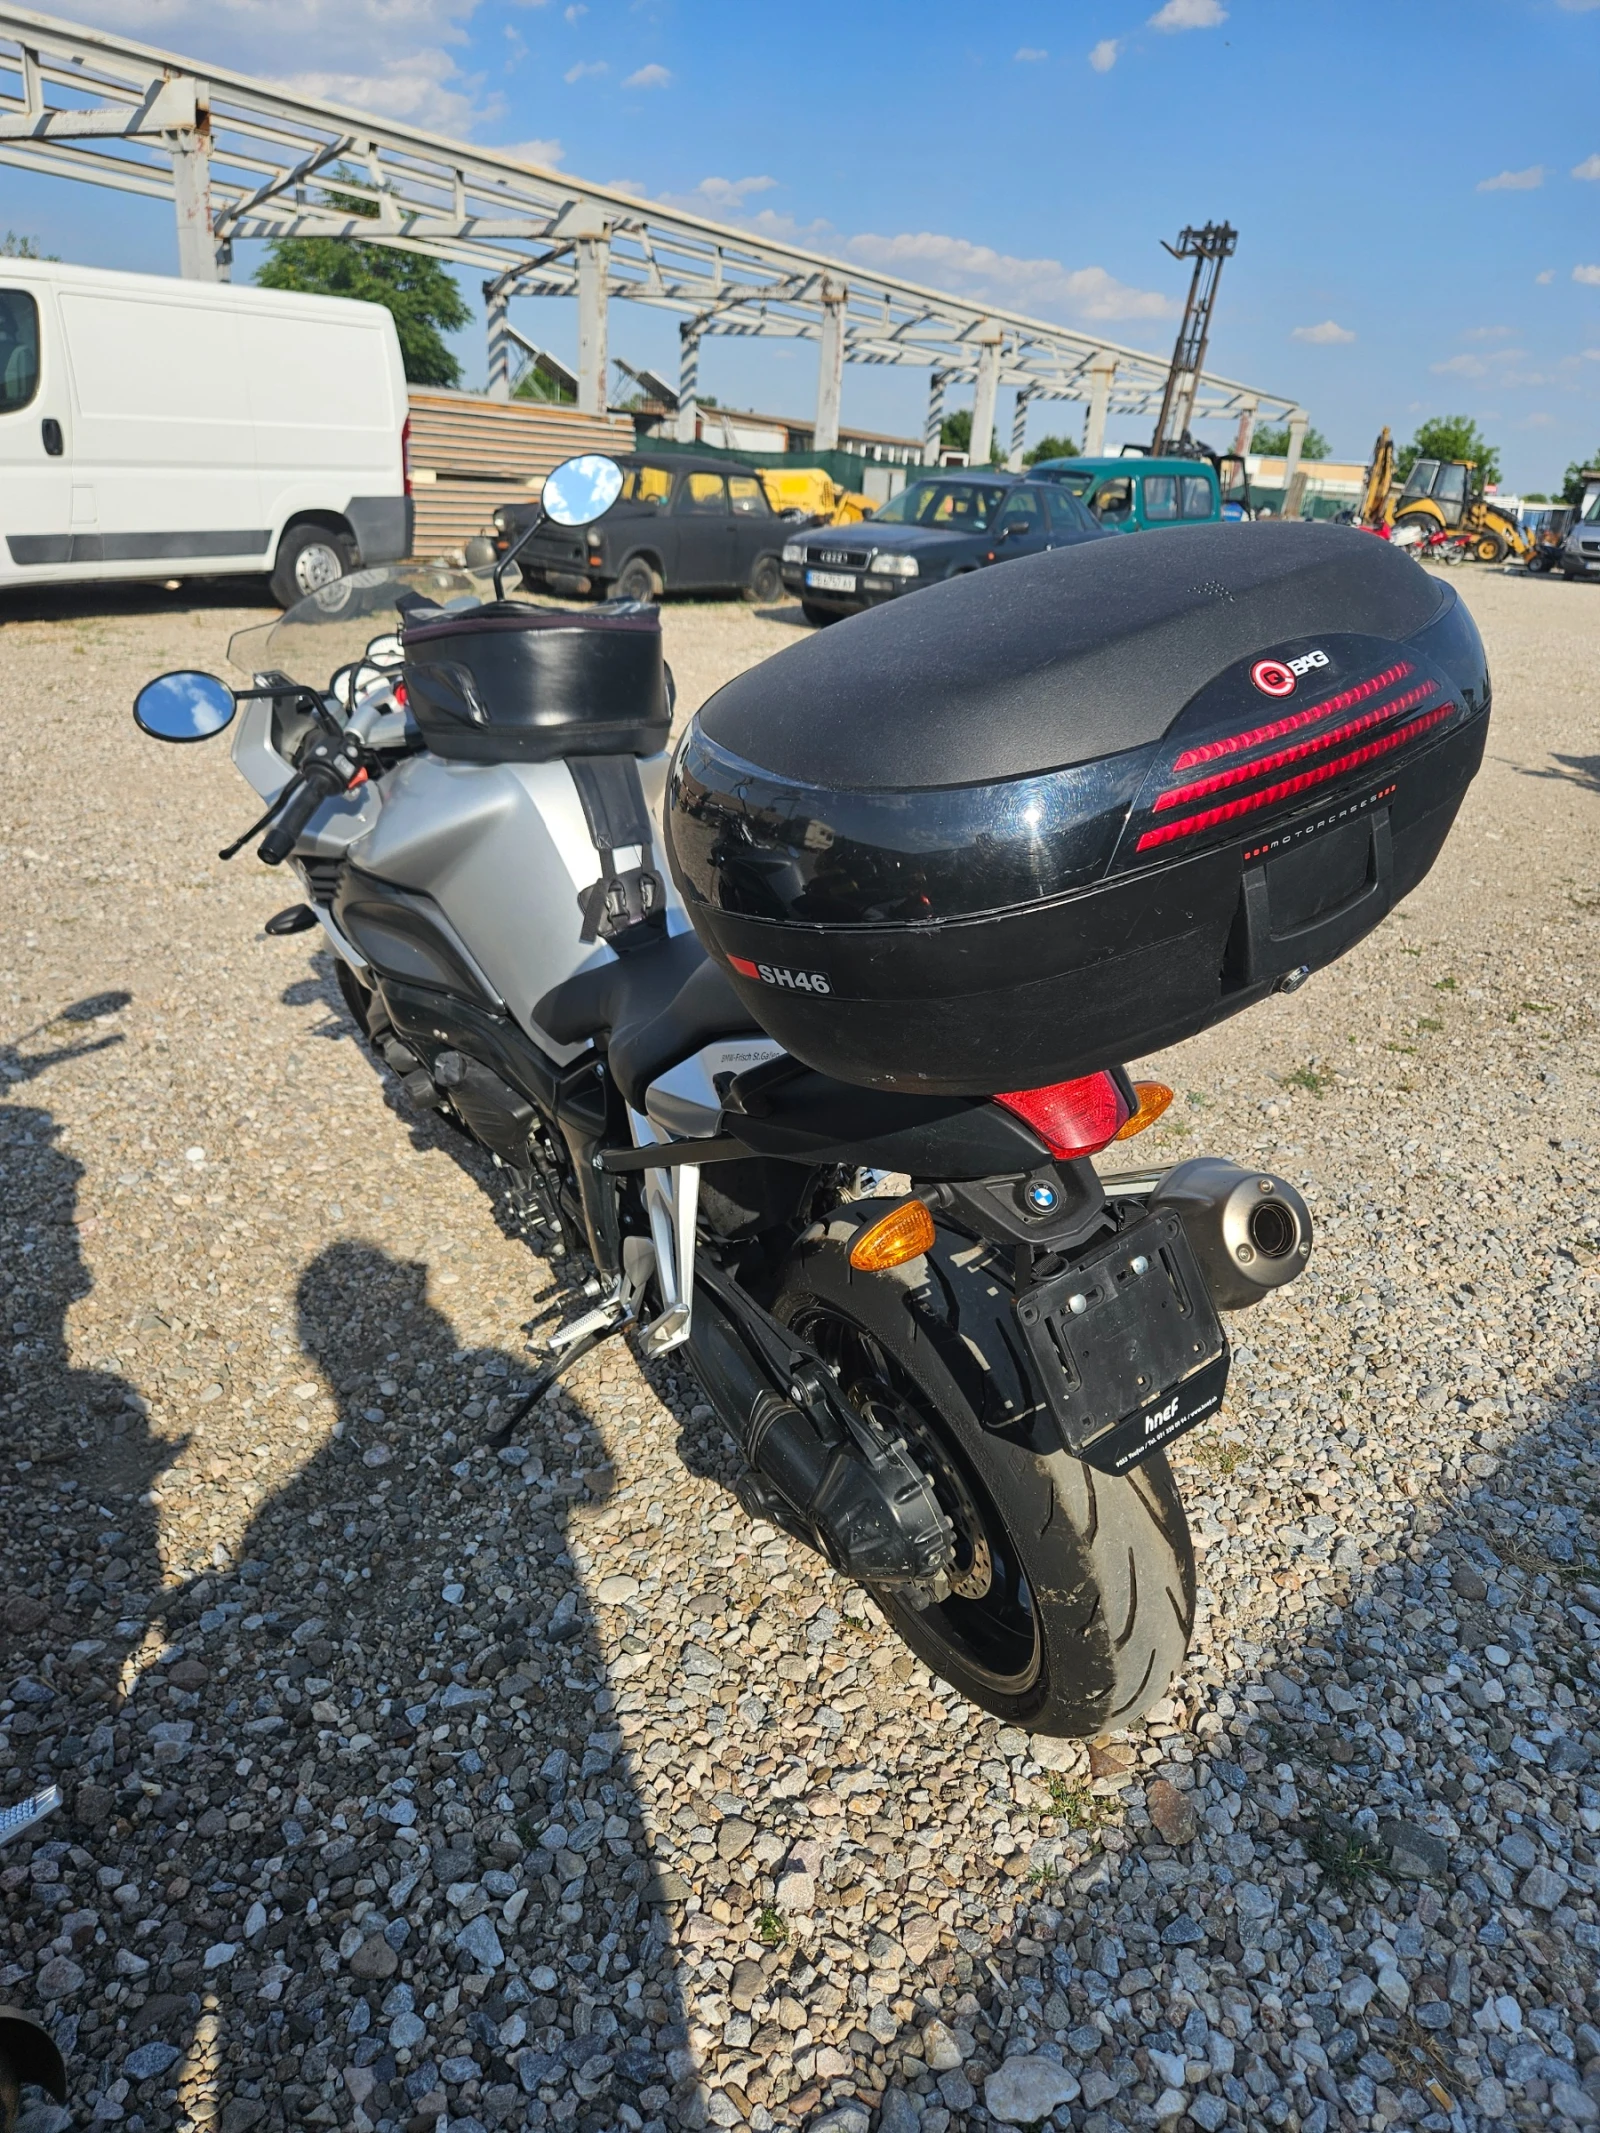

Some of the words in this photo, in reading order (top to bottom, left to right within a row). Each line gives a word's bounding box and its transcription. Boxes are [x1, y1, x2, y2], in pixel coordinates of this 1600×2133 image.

[1270, 794, 1377, 848] MOTORCASES
[758, 964, 830, 994] SH46
[1145, 1396, 1180, 1435] hnef
